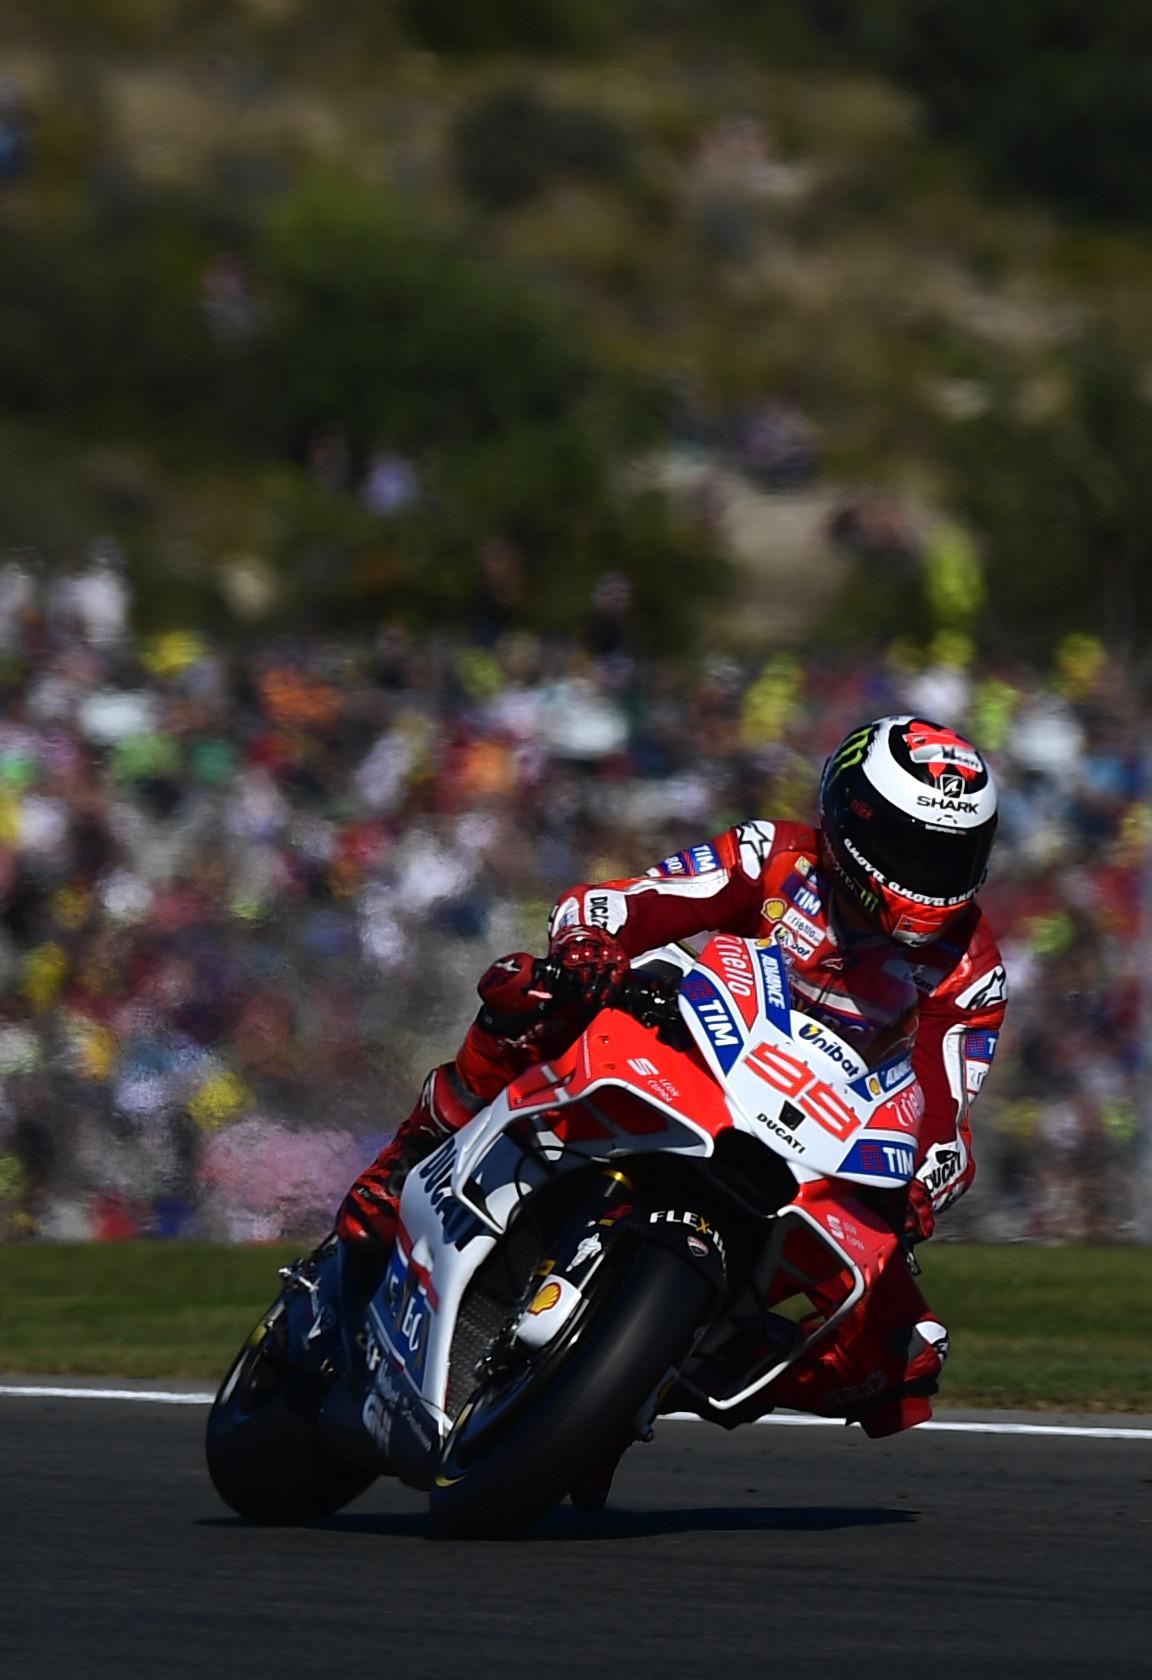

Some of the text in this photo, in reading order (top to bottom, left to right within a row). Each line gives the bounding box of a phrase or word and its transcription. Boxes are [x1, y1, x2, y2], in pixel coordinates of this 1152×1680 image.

[916, 795, 979, 815] SHARK
[693, 844, 716, 872] TIM
[793, 886, 822, 916] TIM
[760, 952, 786, 1011] ADVANCE
[697, 998, 740, 1047] TIM
[798, 1022, 860, 1079] Unibat
[743, 1041, 862, 1143] 99
[756, 1112, 806, 1155] DUCATI
